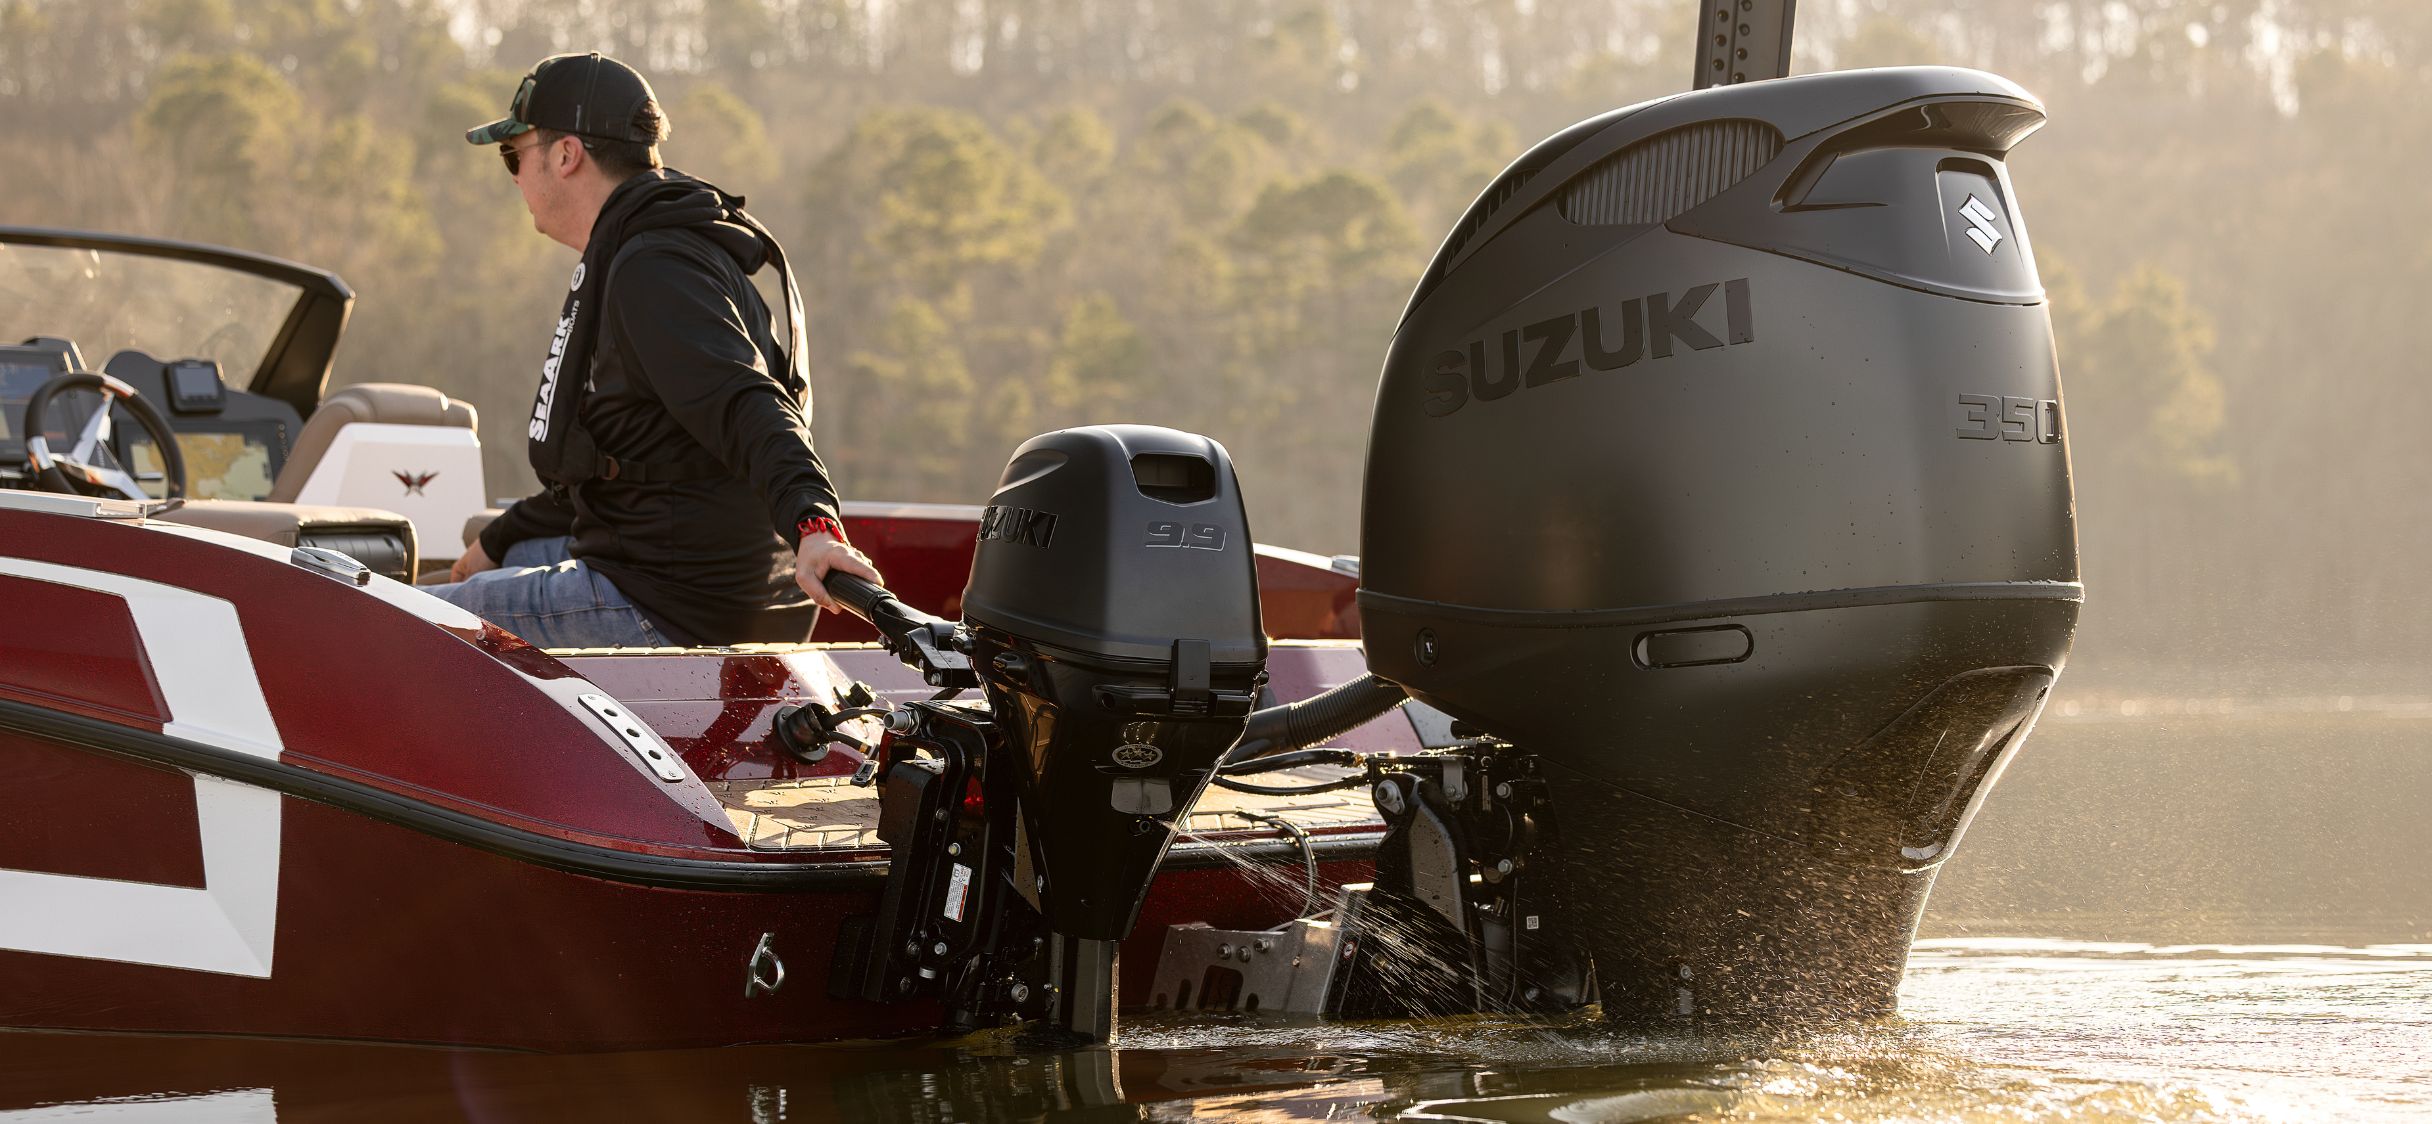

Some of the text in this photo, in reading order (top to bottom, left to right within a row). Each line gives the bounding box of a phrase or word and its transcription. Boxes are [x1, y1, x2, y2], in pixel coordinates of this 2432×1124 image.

[567, 300, 581, 334] BOATS
[1422, 277, 1754, 419] SUZUKI
[528, 316, 571, 442] SEAARK
[1956, 393, 2061, 445] 350
[976, 504, 1059, 551] UZUKI
[1145, 520, 1227, 552] 9.9
